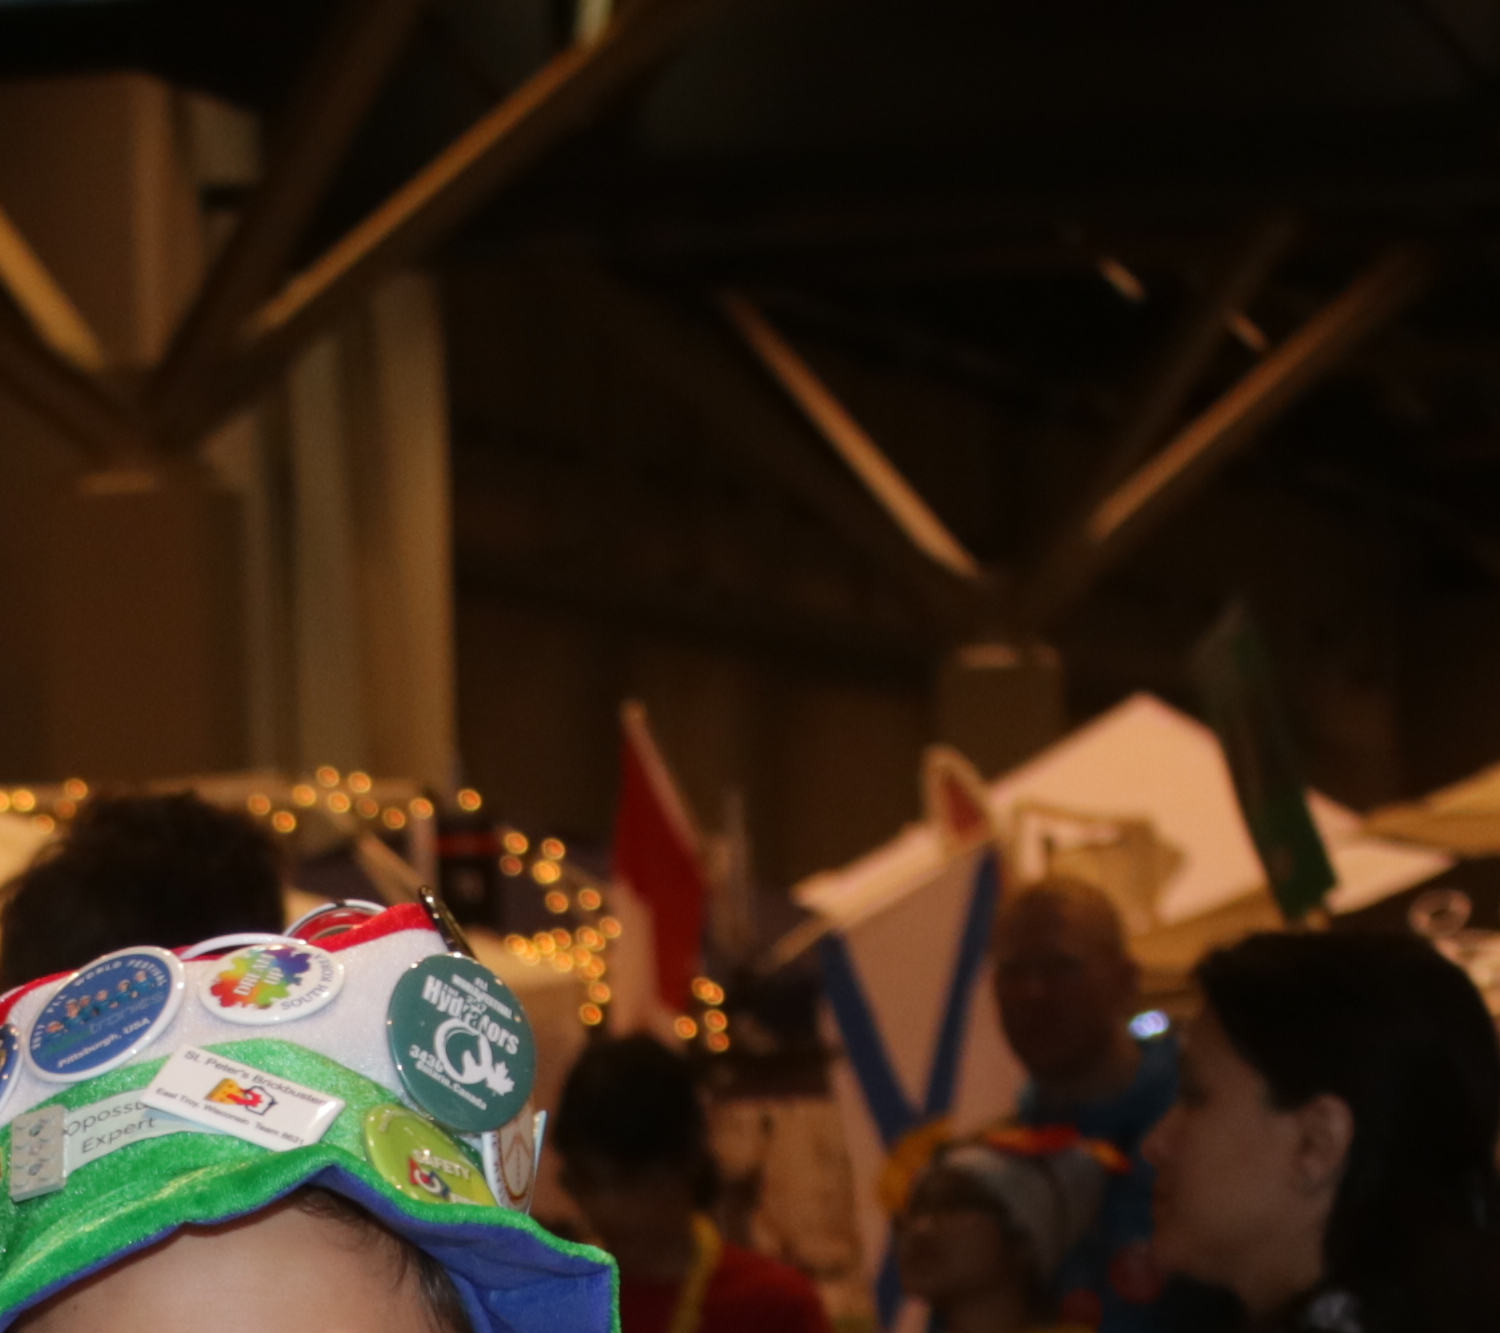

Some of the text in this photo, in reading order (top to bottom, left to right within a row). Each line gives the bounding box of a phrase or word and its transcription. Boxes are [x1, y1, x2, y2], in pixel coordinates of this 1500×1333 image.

[73, 961, 122, 987] WORLD
[126, 959, 168, 987] FESTIVAL
[281, 983, 328, 1010] SOUTH
[57, 1033, 122, 1068] Pittsburgh,
[123, 1017, 150, 1034] USA
[204, 1056, 249, 1081] Peter's
[202, 1103, 252, 1127] Wisconsin
[254, 1117, 280, 1136] Team
[81, 1117, 158, 1154] Expert
[413, 1150, 471, 1180] SAFETY
